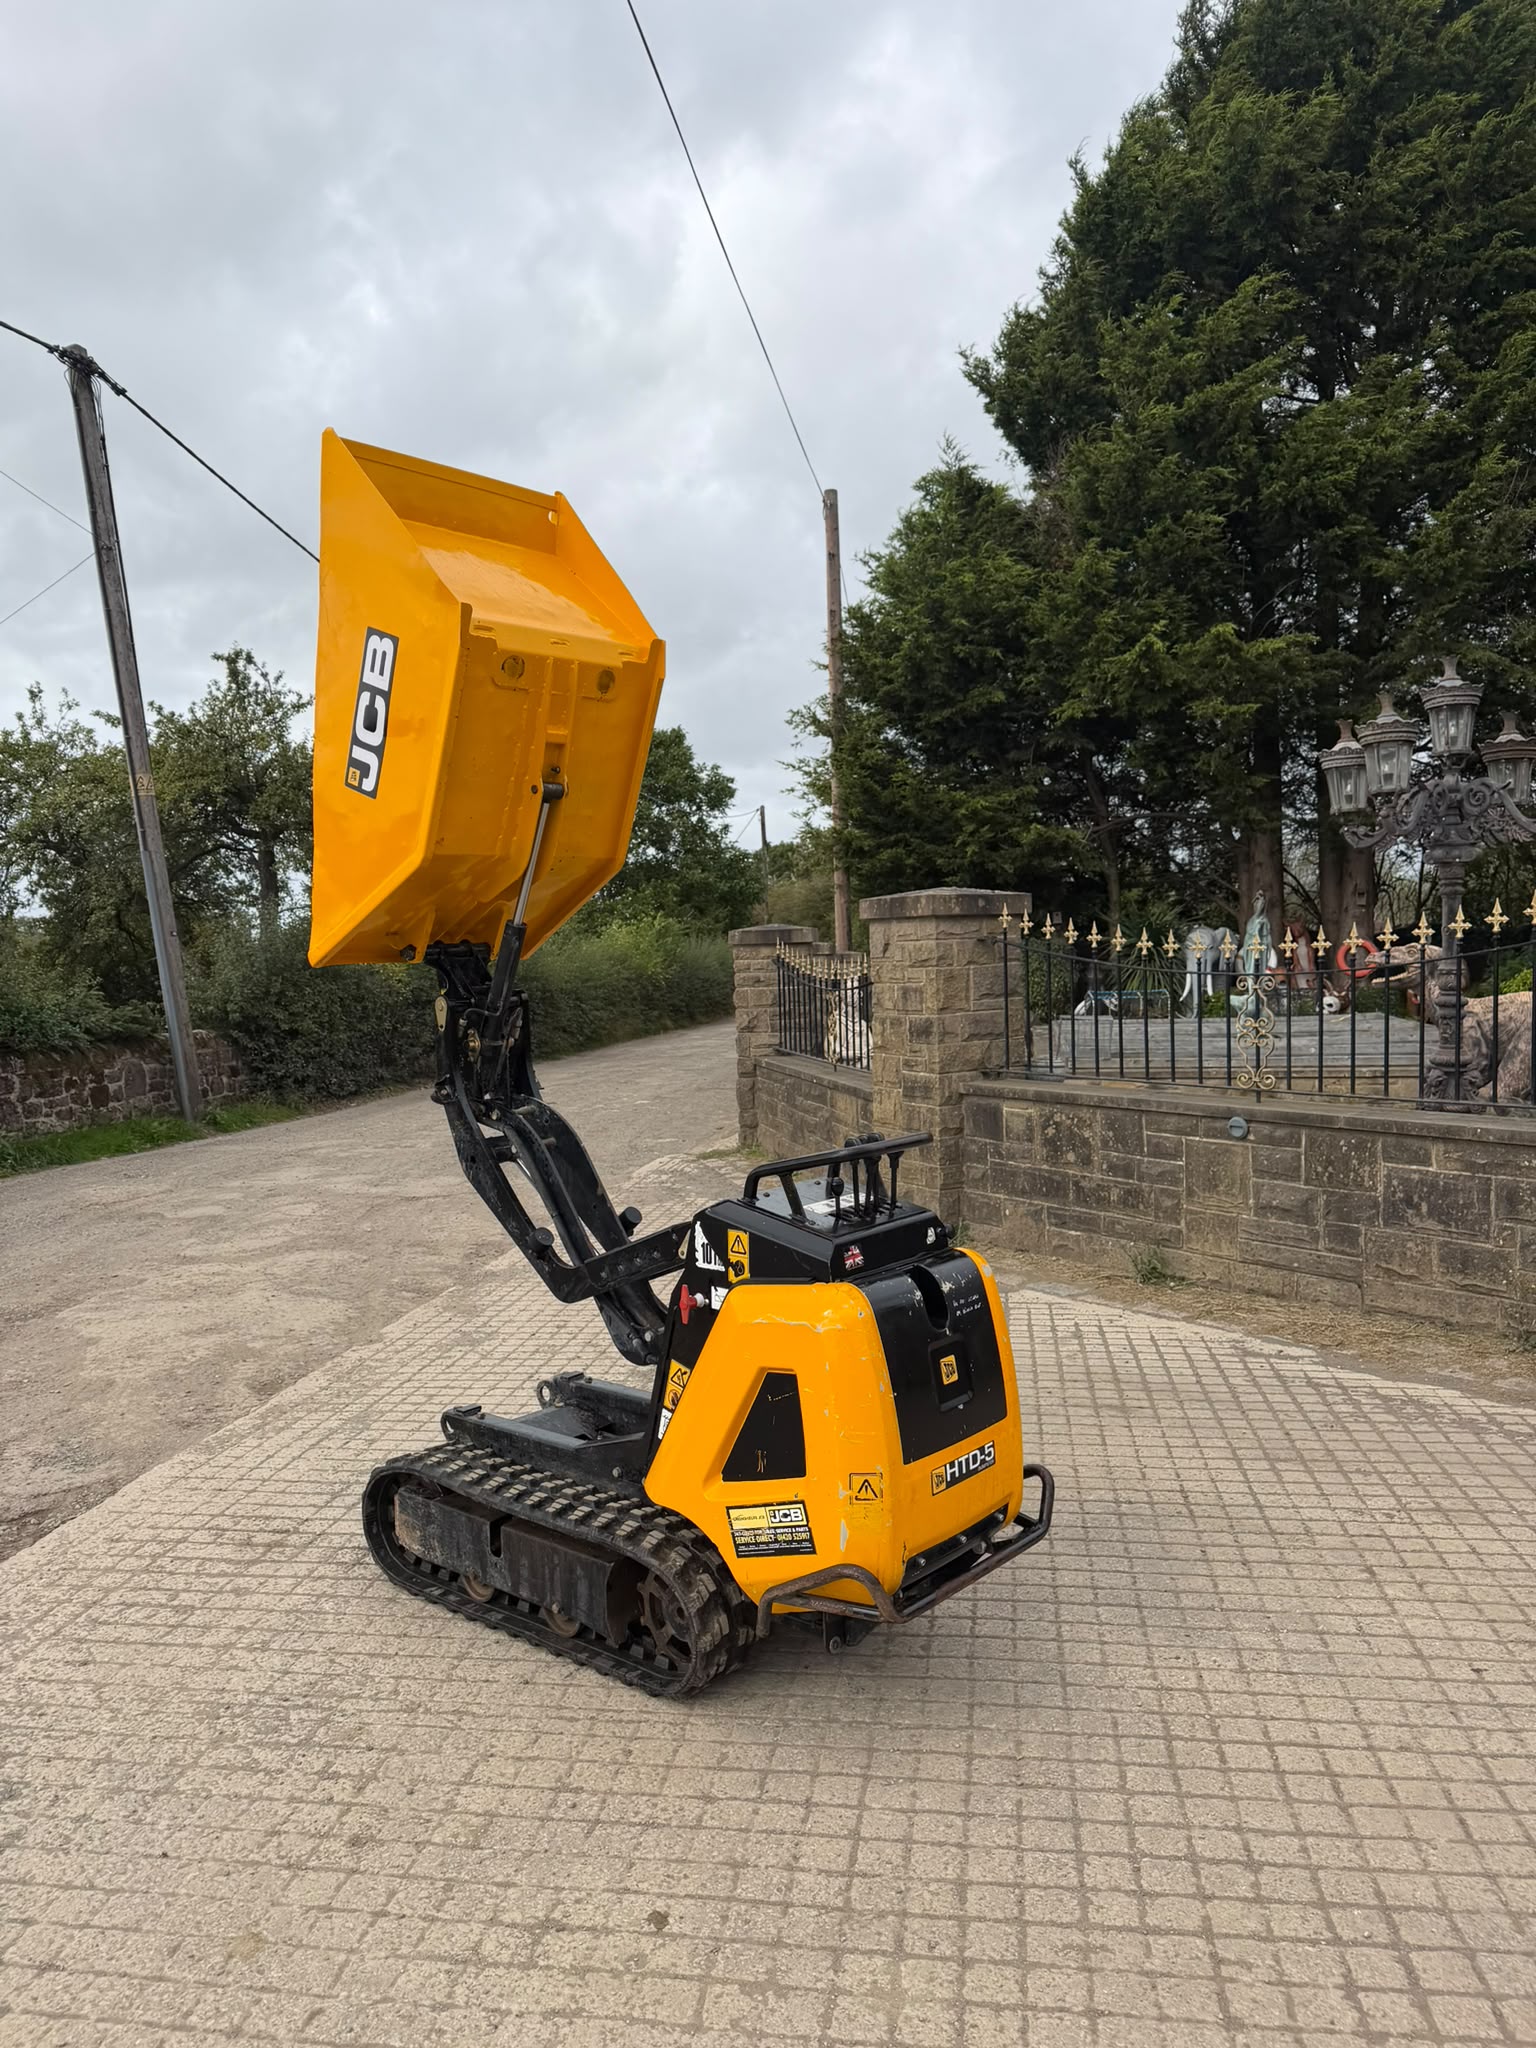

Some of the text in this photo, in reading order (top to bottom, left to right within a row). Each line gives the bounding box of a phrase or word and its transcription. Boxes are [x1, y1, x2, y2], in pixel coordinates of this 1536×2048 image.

[351, 634, 394, 792] JCB
[946, 1441, 995, 1481] HTD-5
[771, 1508, 803, 1523] JCB
[735, 1535, 756, 1544] SERVICE
